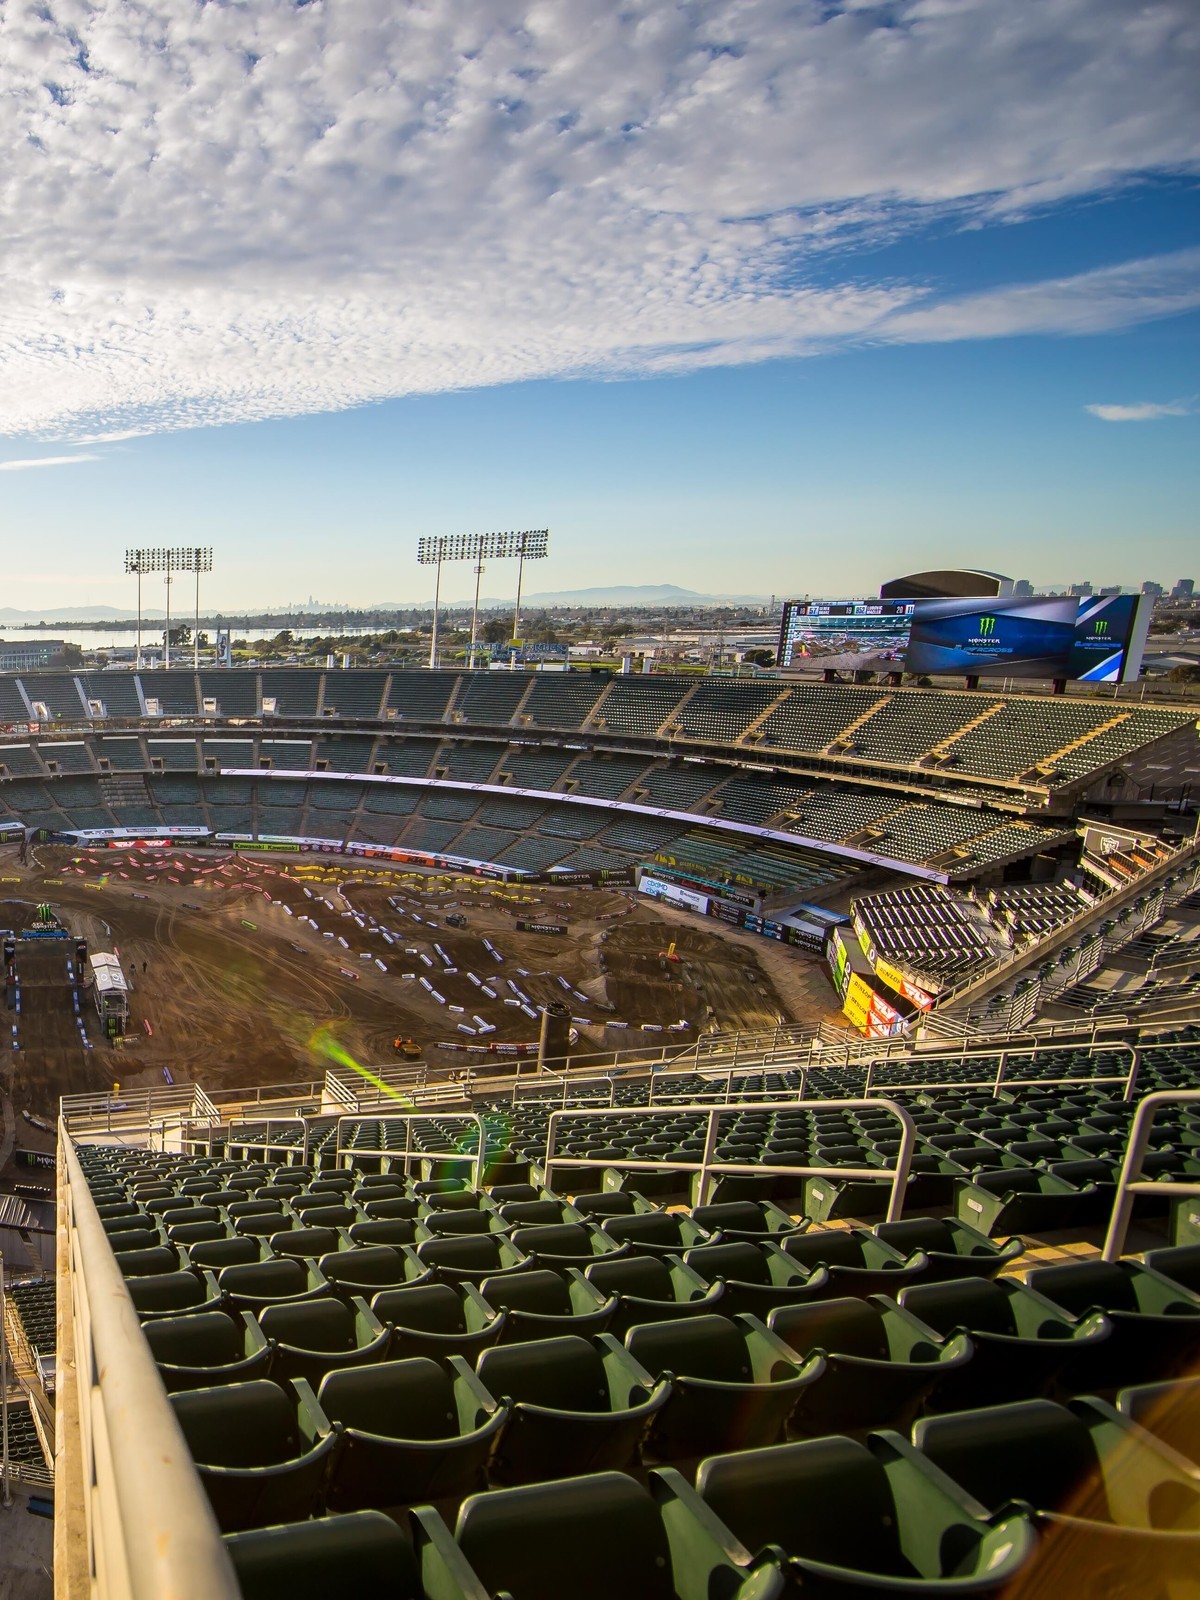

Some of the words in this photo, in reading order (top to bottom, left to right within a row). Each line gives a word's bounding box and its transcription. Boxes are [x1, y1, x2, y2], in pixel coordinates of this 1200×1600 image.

[374, 851, 392, 859] KTM
[408, 855, 427, 864] KTM
[653, 871, 675, 880] MONSTER
[647, 880, 668, 891] cbdMD
[726, 892, 750, 903] MONSTER
[796, 930, 823, 942] MONSTER
[794, 938, 822, 952] MONSTER
[879, 967, 900, 984] DUNLOP
[854, 981, 872, 999] DUNLOP
[852, 997, 867, 1015] DUNLOP
